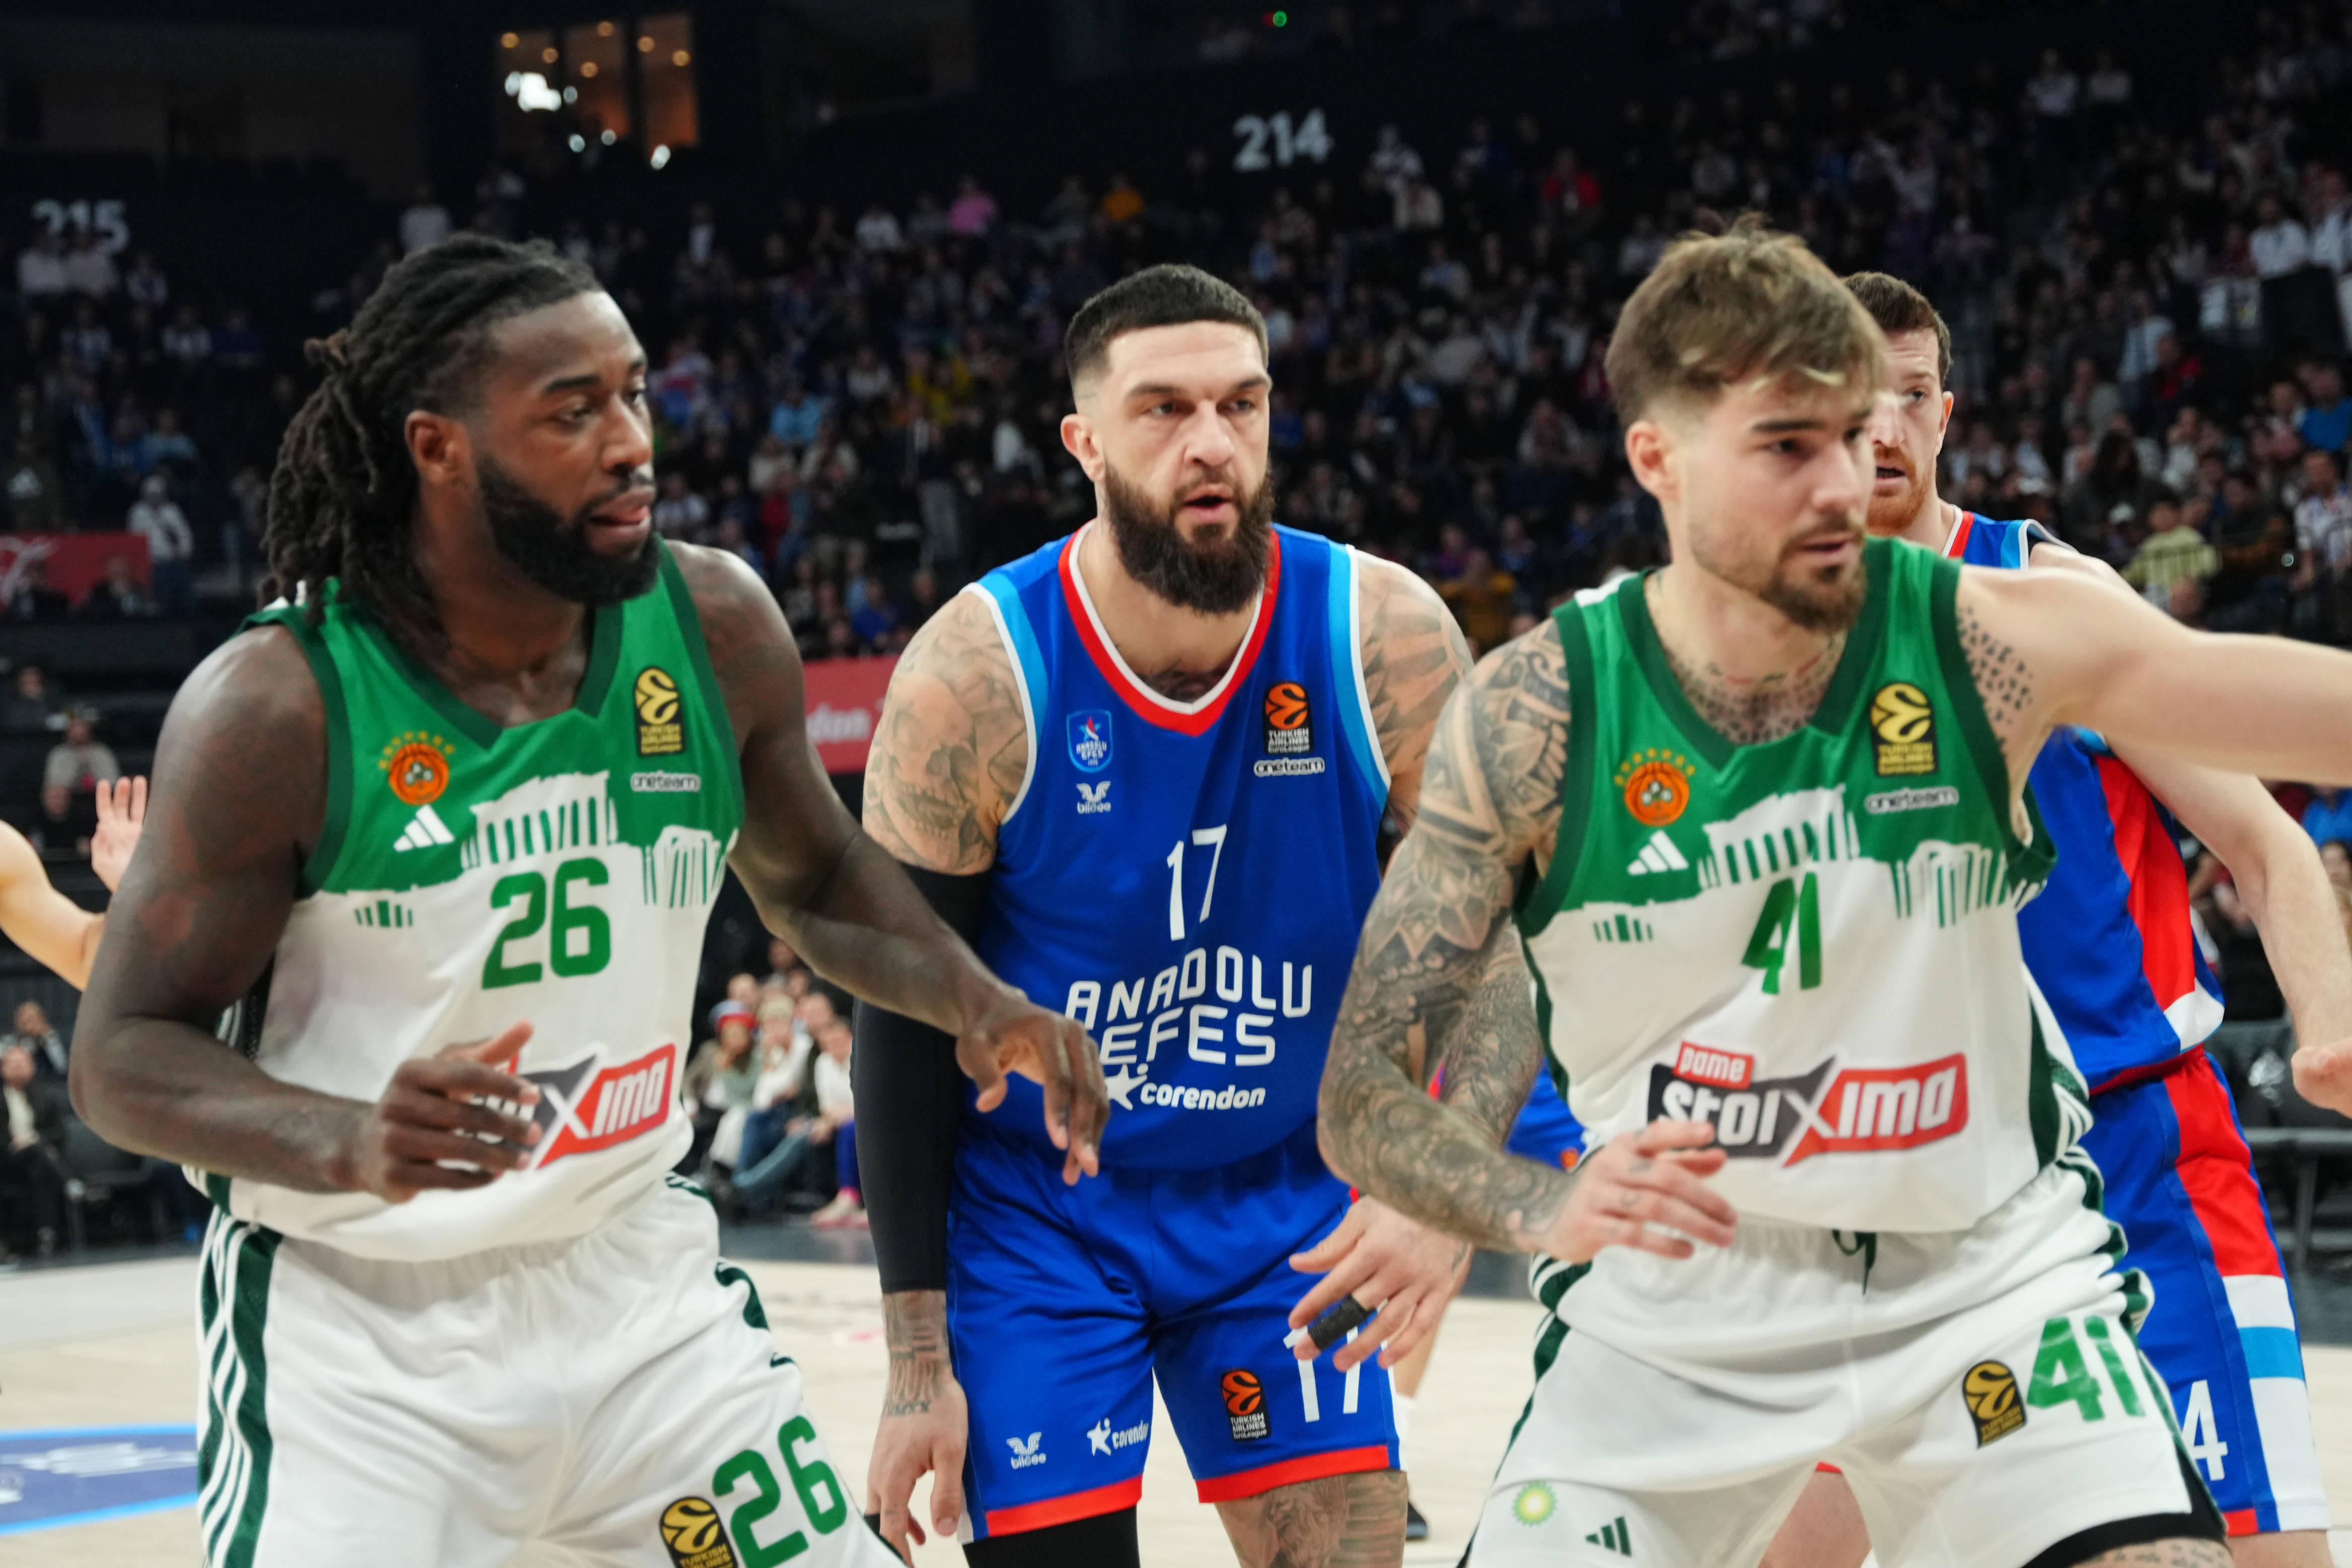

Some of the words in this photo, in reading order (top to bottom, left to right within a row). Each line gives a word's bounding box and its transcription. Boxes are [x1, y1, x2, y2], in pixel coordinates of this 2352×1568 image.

[1234, 109, 1334, 172] 214
[1255, 759, 1324, 775] oneteam
[481, 858, 611, 990] 26
[1166, 824, 1227, 941] 17
[1741, 871, 1822, 995] 41
[1064, 945, 1312, 1030] ANADOLU
[1099, 1004, 1275, 1066] EFES
[1140, 1082, 1266, 1110] corendon
[2027, 1315, 2146, 1422] 41
[1230, 1412, 1265, 1424] TURKISH
[711, 1415, 847, 1568] 26
